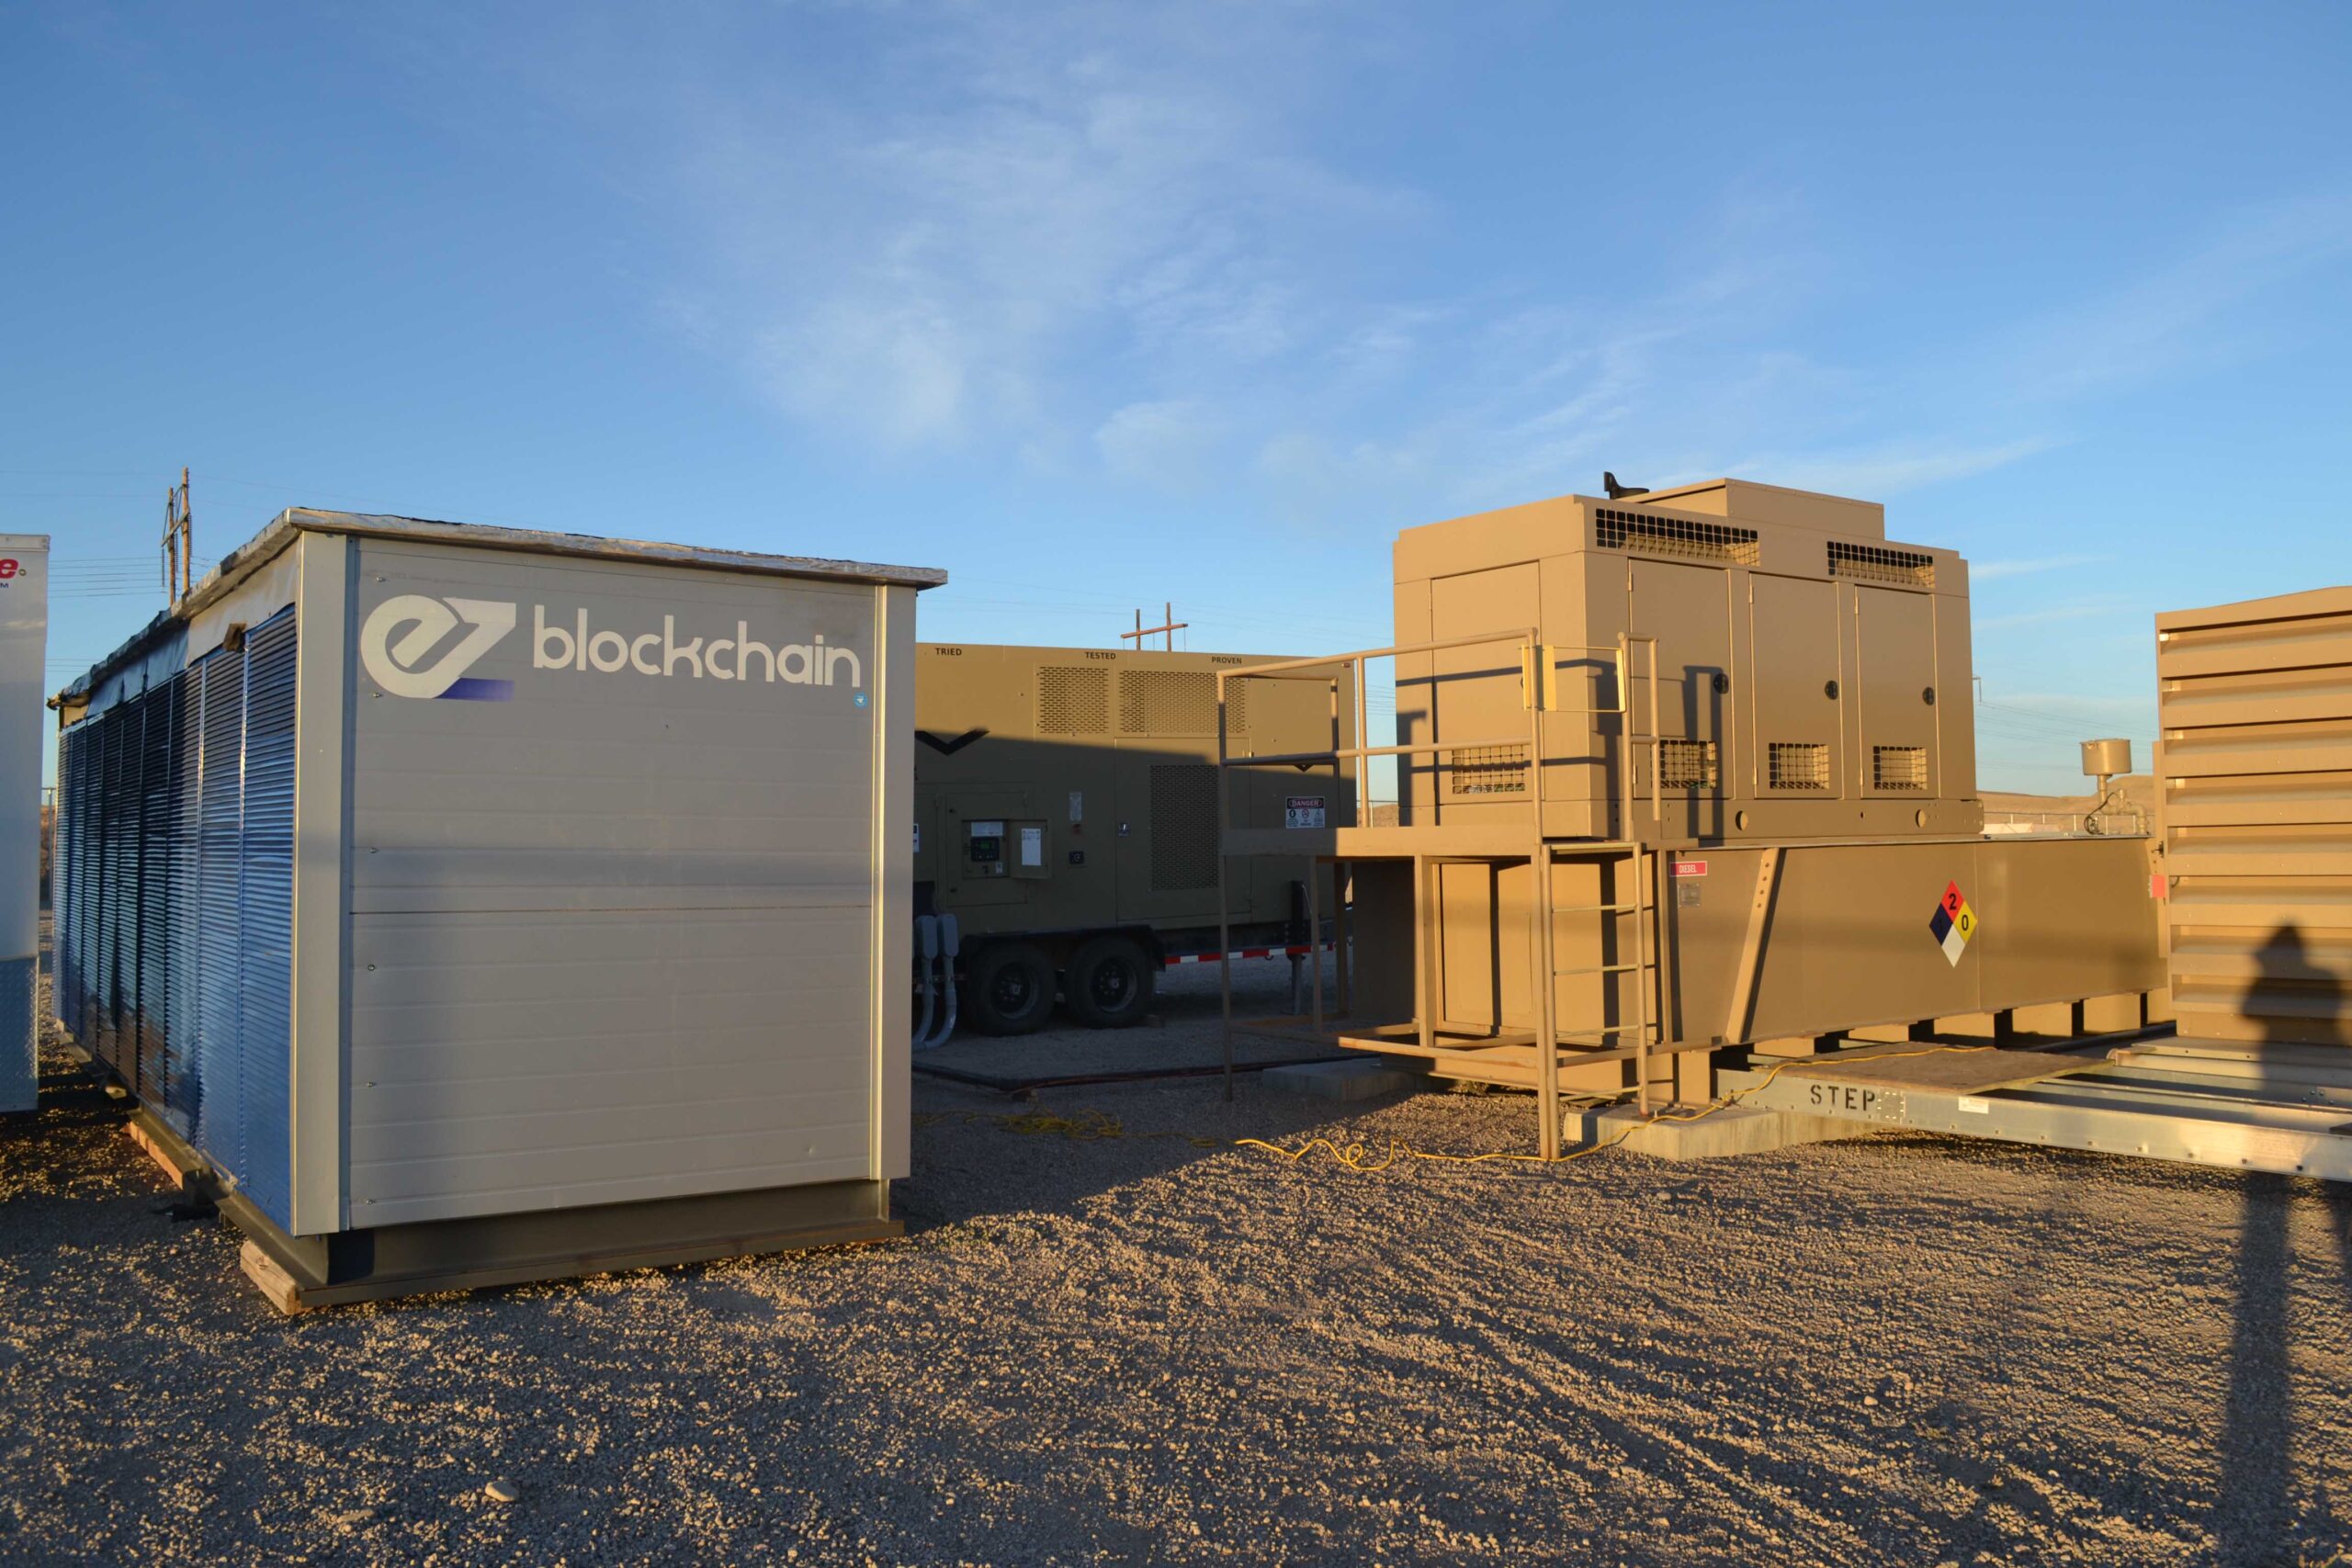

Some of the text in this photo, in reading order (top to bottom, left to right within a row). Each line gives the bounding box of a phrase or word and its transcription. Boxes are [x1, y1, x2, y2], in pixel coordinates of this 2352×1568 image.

[533, 604, 861, 688] blockchain
[935, 648, 1242, 664] TRIED TESTED PROVEN
[1679, 864, 1697, 874] DIESEL
[1949, 893, 1957, 910] 2
[1962, 914, 1969, 931] 0
[1810, 1084, 1875, 1111] STEP
